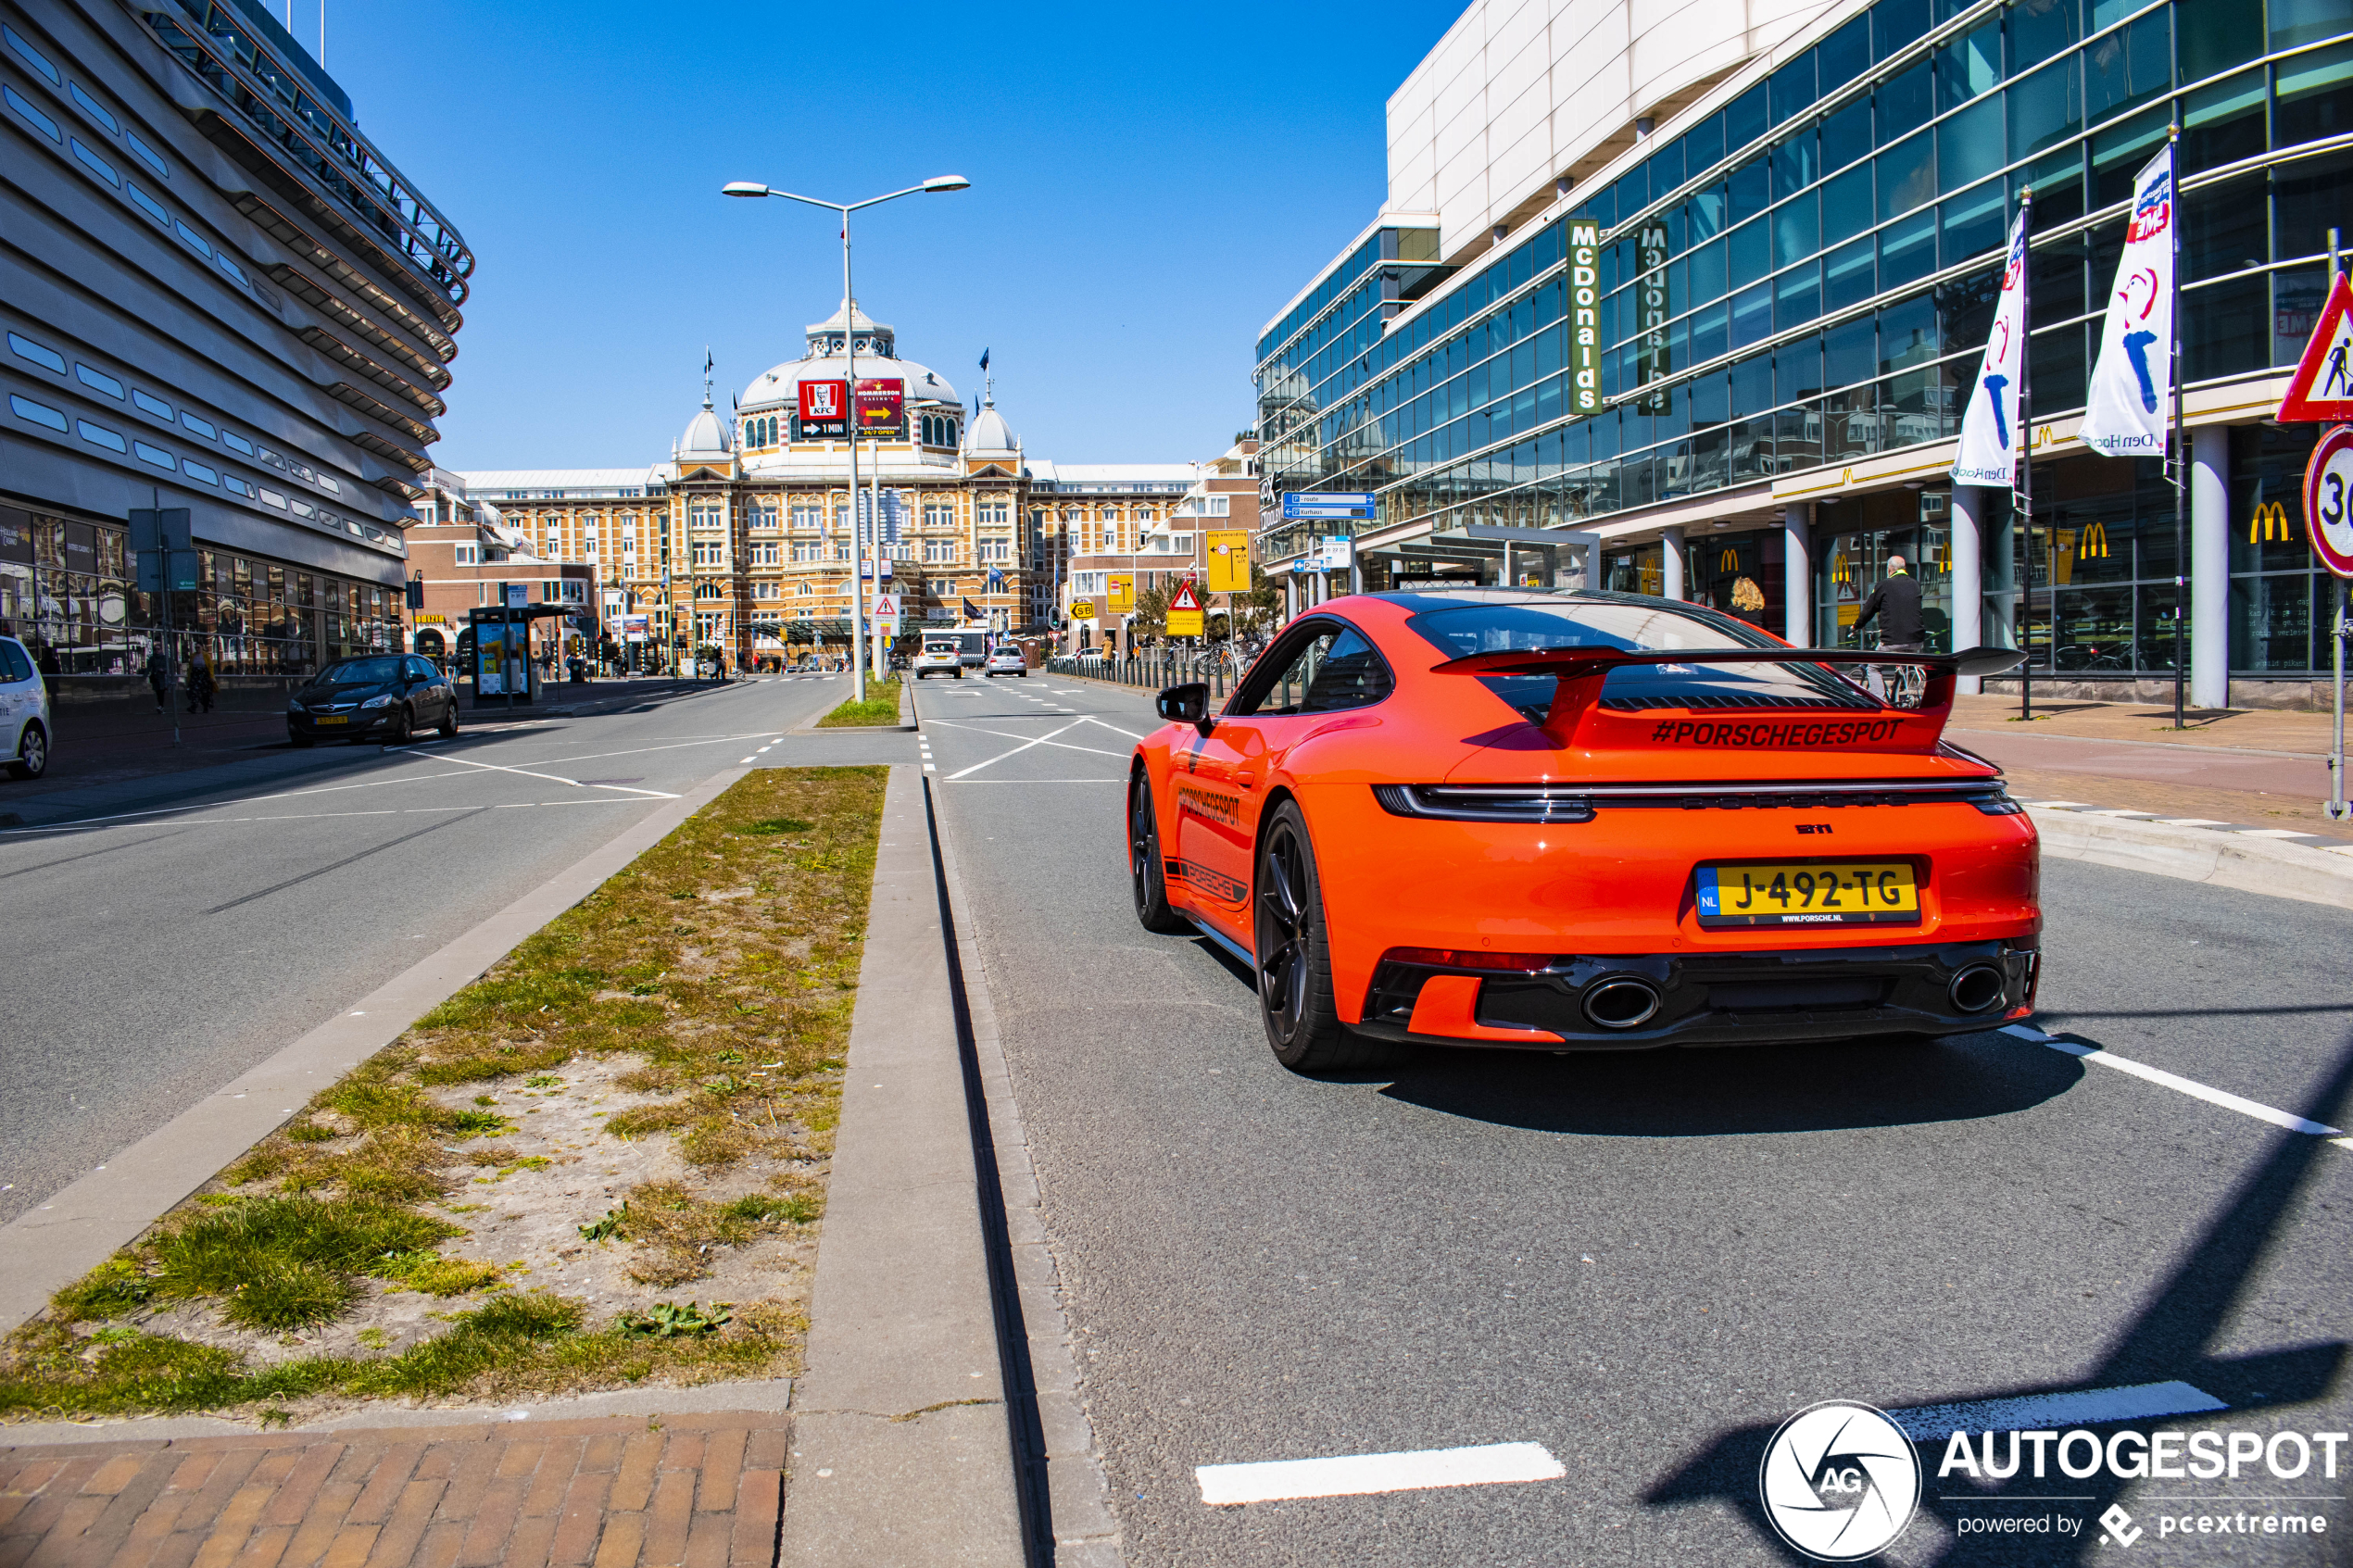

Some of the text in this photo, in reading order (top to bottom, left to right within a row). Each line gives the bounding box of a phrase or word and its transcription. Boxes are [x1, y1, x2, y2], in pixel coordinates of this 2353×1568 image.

[1571, 225, 1597, 409] McDonalds
[822, 424, 844, 433] 1 MIN
[1651, 719, 1905, 746] #PORSCHEGESPOT
[1178, 786, 1239, 827] #PORSCHEGESPOT
[1794, 823, 1833, 834] 911
[1189, 865, 1233, 897] PORSCHE
[1701, 871, 1901, 909] NL J-492-TG
[1780, 914, 1843, 922] WWW.PORSCHE.NL
